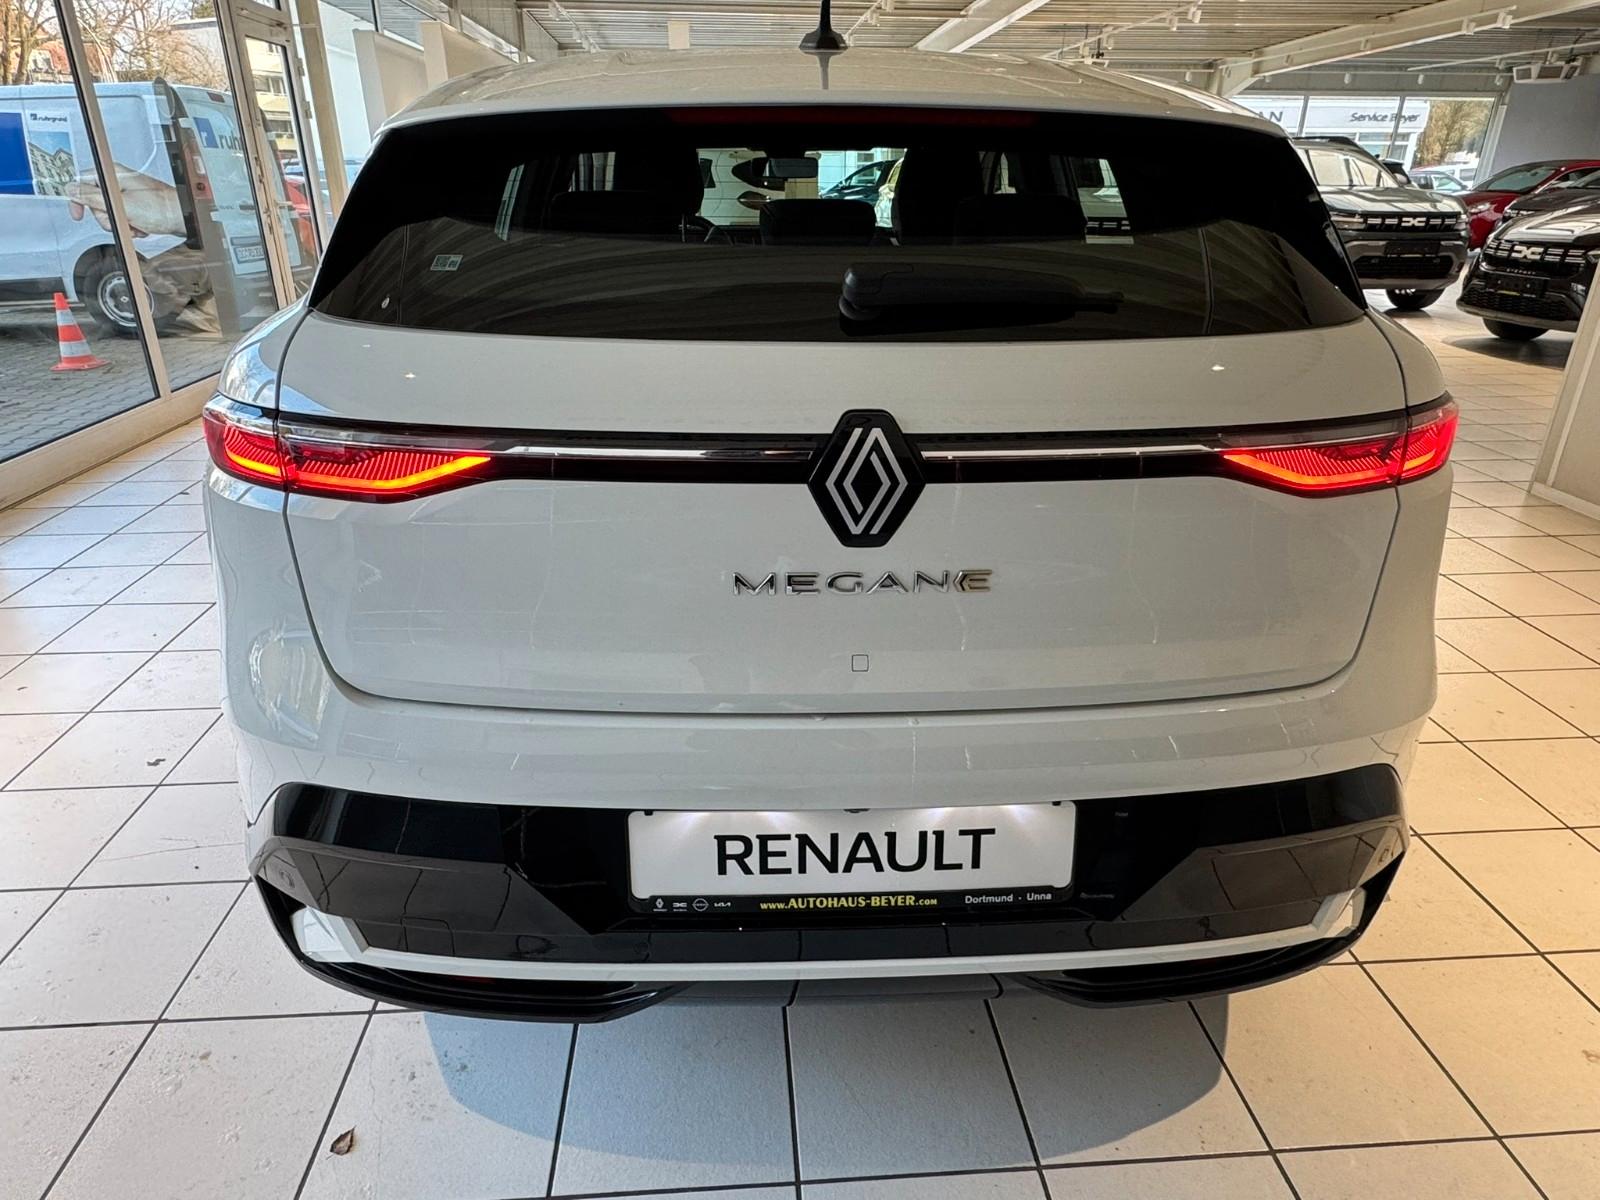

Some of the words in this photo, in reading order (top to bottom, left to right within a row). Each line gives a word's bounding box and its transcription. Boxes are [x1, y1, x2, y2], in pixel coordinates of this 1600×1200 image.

[1350, 112, 1389, 122] Service
[732, 569, 993, 597] MEGANE
[713, 827, 996, 876] RENAULT
[965, 893, 1013, 904] Dortmund
[1026, 892, 1052, 901] Unna
